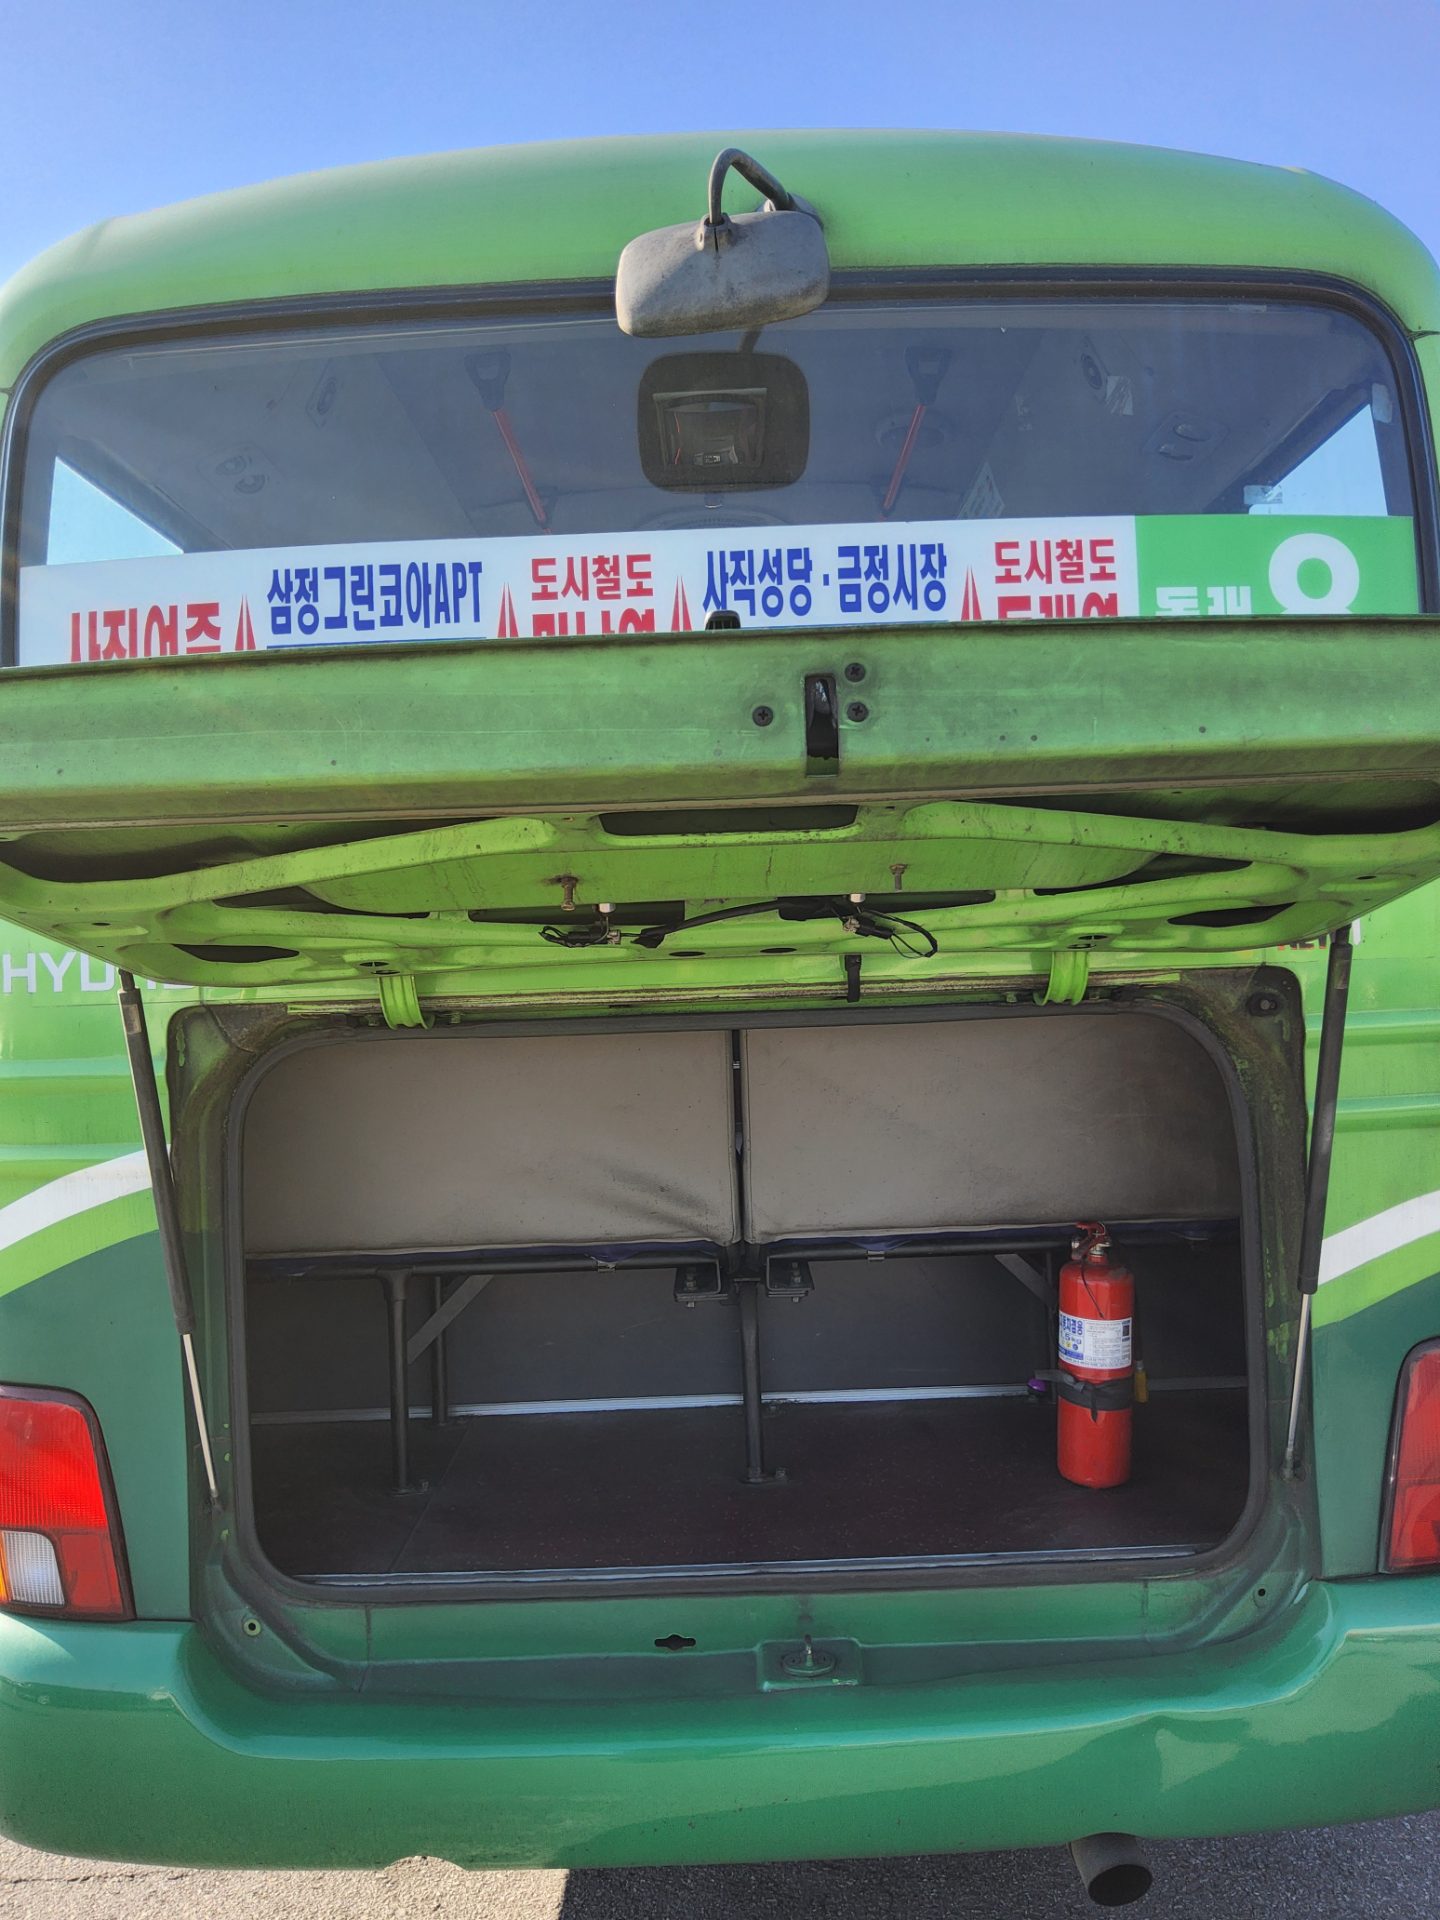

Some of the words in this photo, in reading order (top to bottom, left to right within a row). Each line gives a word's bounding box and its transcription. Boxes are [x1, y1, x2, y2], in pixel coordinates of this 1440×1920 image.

[531, 554, 654, 601] 도시철도
[994, 539, 1116, 584] 도시철도
[266, 561, 484, 635] 삼정그린코아APT
